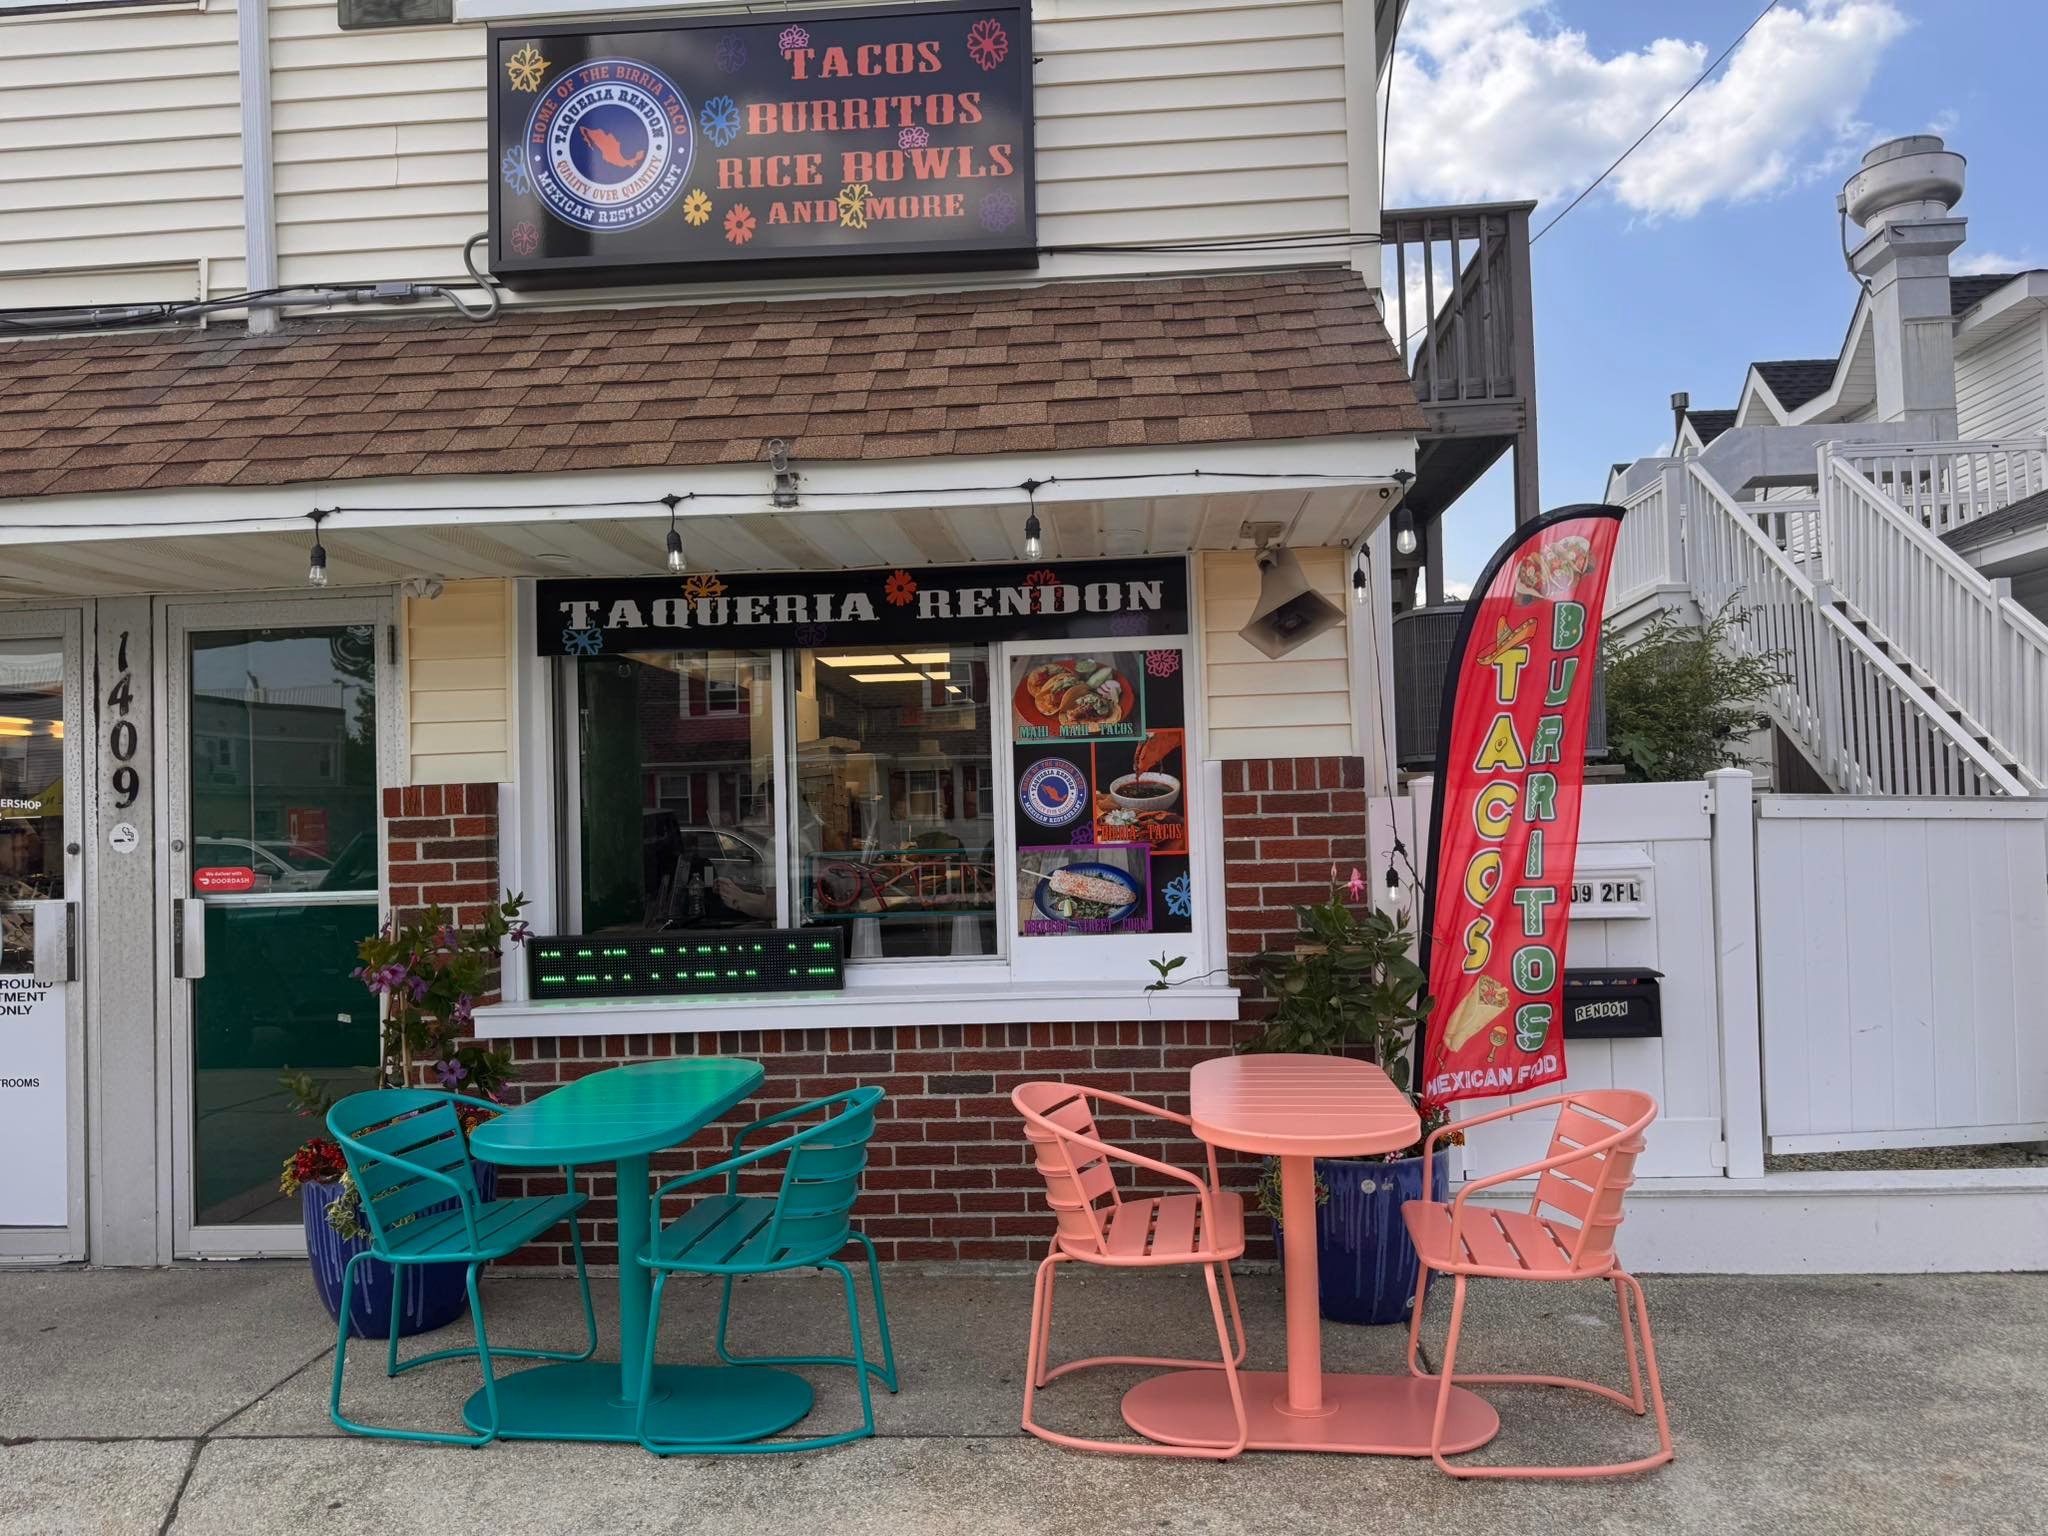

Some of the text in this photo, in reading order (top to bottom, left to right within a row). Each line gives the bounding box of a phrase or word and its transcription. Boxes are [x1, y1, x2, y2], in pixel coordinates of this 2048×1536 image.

[784, 41, 943, 80] TACOS
[532, 66, 688, 144] HOME OF THE BIRRIA TACO
[555, 89, 665, 145] TAQUERIA RENDON
[746, 92, 984, 135] BURRITOS
[556, 154, 663, 201] QUALITY OVER QUANTITY
[716, 144, 1015, 190] RICE BOWLS
[538, 164, 682, 224] MEXICAN RESTAURANT
[767, 194, 965, 225] AND MORE
[559, 580, 1164, 631] TAQUERIA RENDON
[107, 630, 140, 809] 1409
[1100, 722, 1133, 735] TACOS
[1148, 823, 1182, 840] TACOS
[1462, 644, 1530, 974] TACOS
[1511, 601, 1587, 1052] BURRITOS
[1601, 883, 1641, 903] 2FL
[1575, 1001, 1628, 1021] RENDON
[0, 1078, 40, 1088] ROOMS
